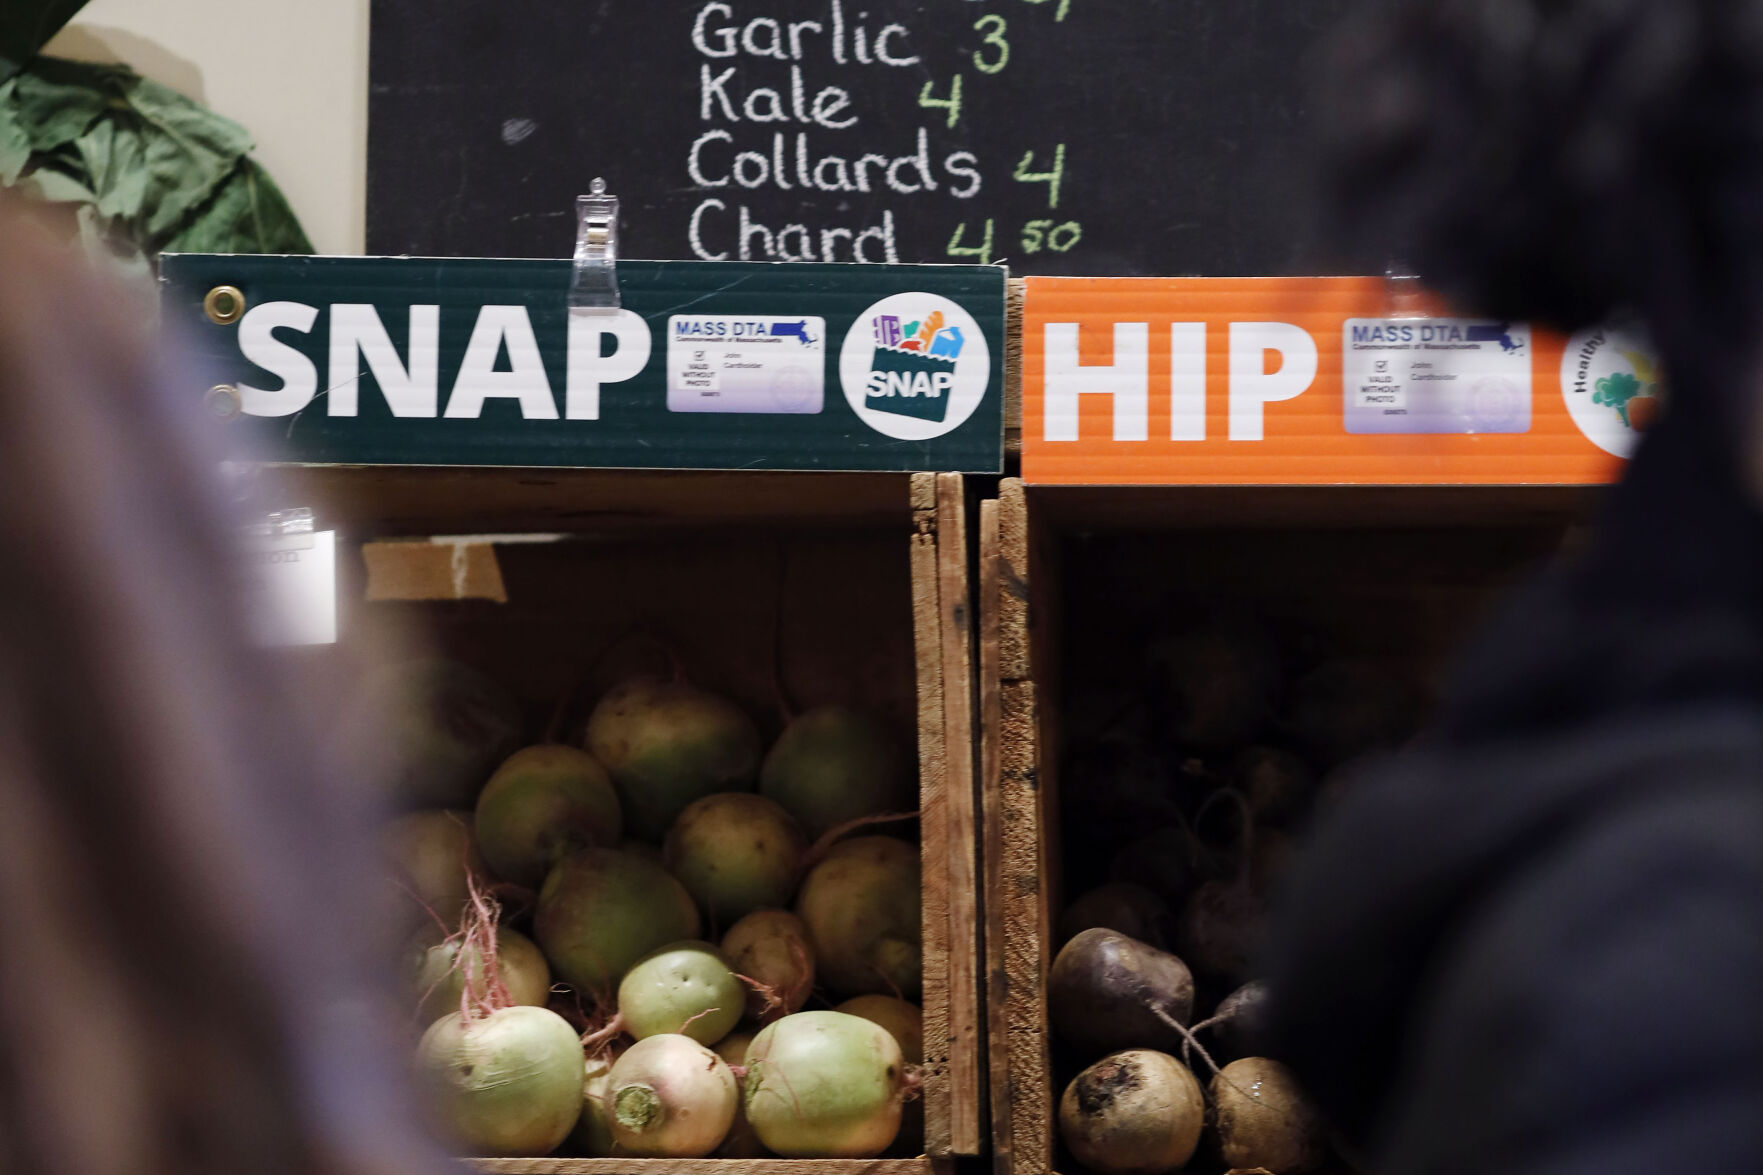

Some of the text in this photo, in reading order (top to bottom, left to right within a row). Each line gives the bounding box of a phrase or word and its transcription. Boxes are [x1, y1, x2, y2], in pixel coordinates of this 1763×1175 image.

[692, 0, 1009, 74] Garlic 3
[701, 64, 962, 129] Kale 4
[688, 127, 1065, 208] Collards 4
[689, 199, 1082, 265] Chard 4 50
[676, 321, 768, 336] MASS DTA
[1352, 325, 1464, 342] MASS DTA
[237, 301, 652, 420] SNAP
[866, 370, 955, 398] SNAP
[1044, 322, 1318, 441] HIP
[1361, 385, 1401, 393] WITHOUT
[1368, 375, 1393, 383] VALID
[1573, 330, 1606, 393] Healthy
[1366, 395, 1395, 403] PHOTO
